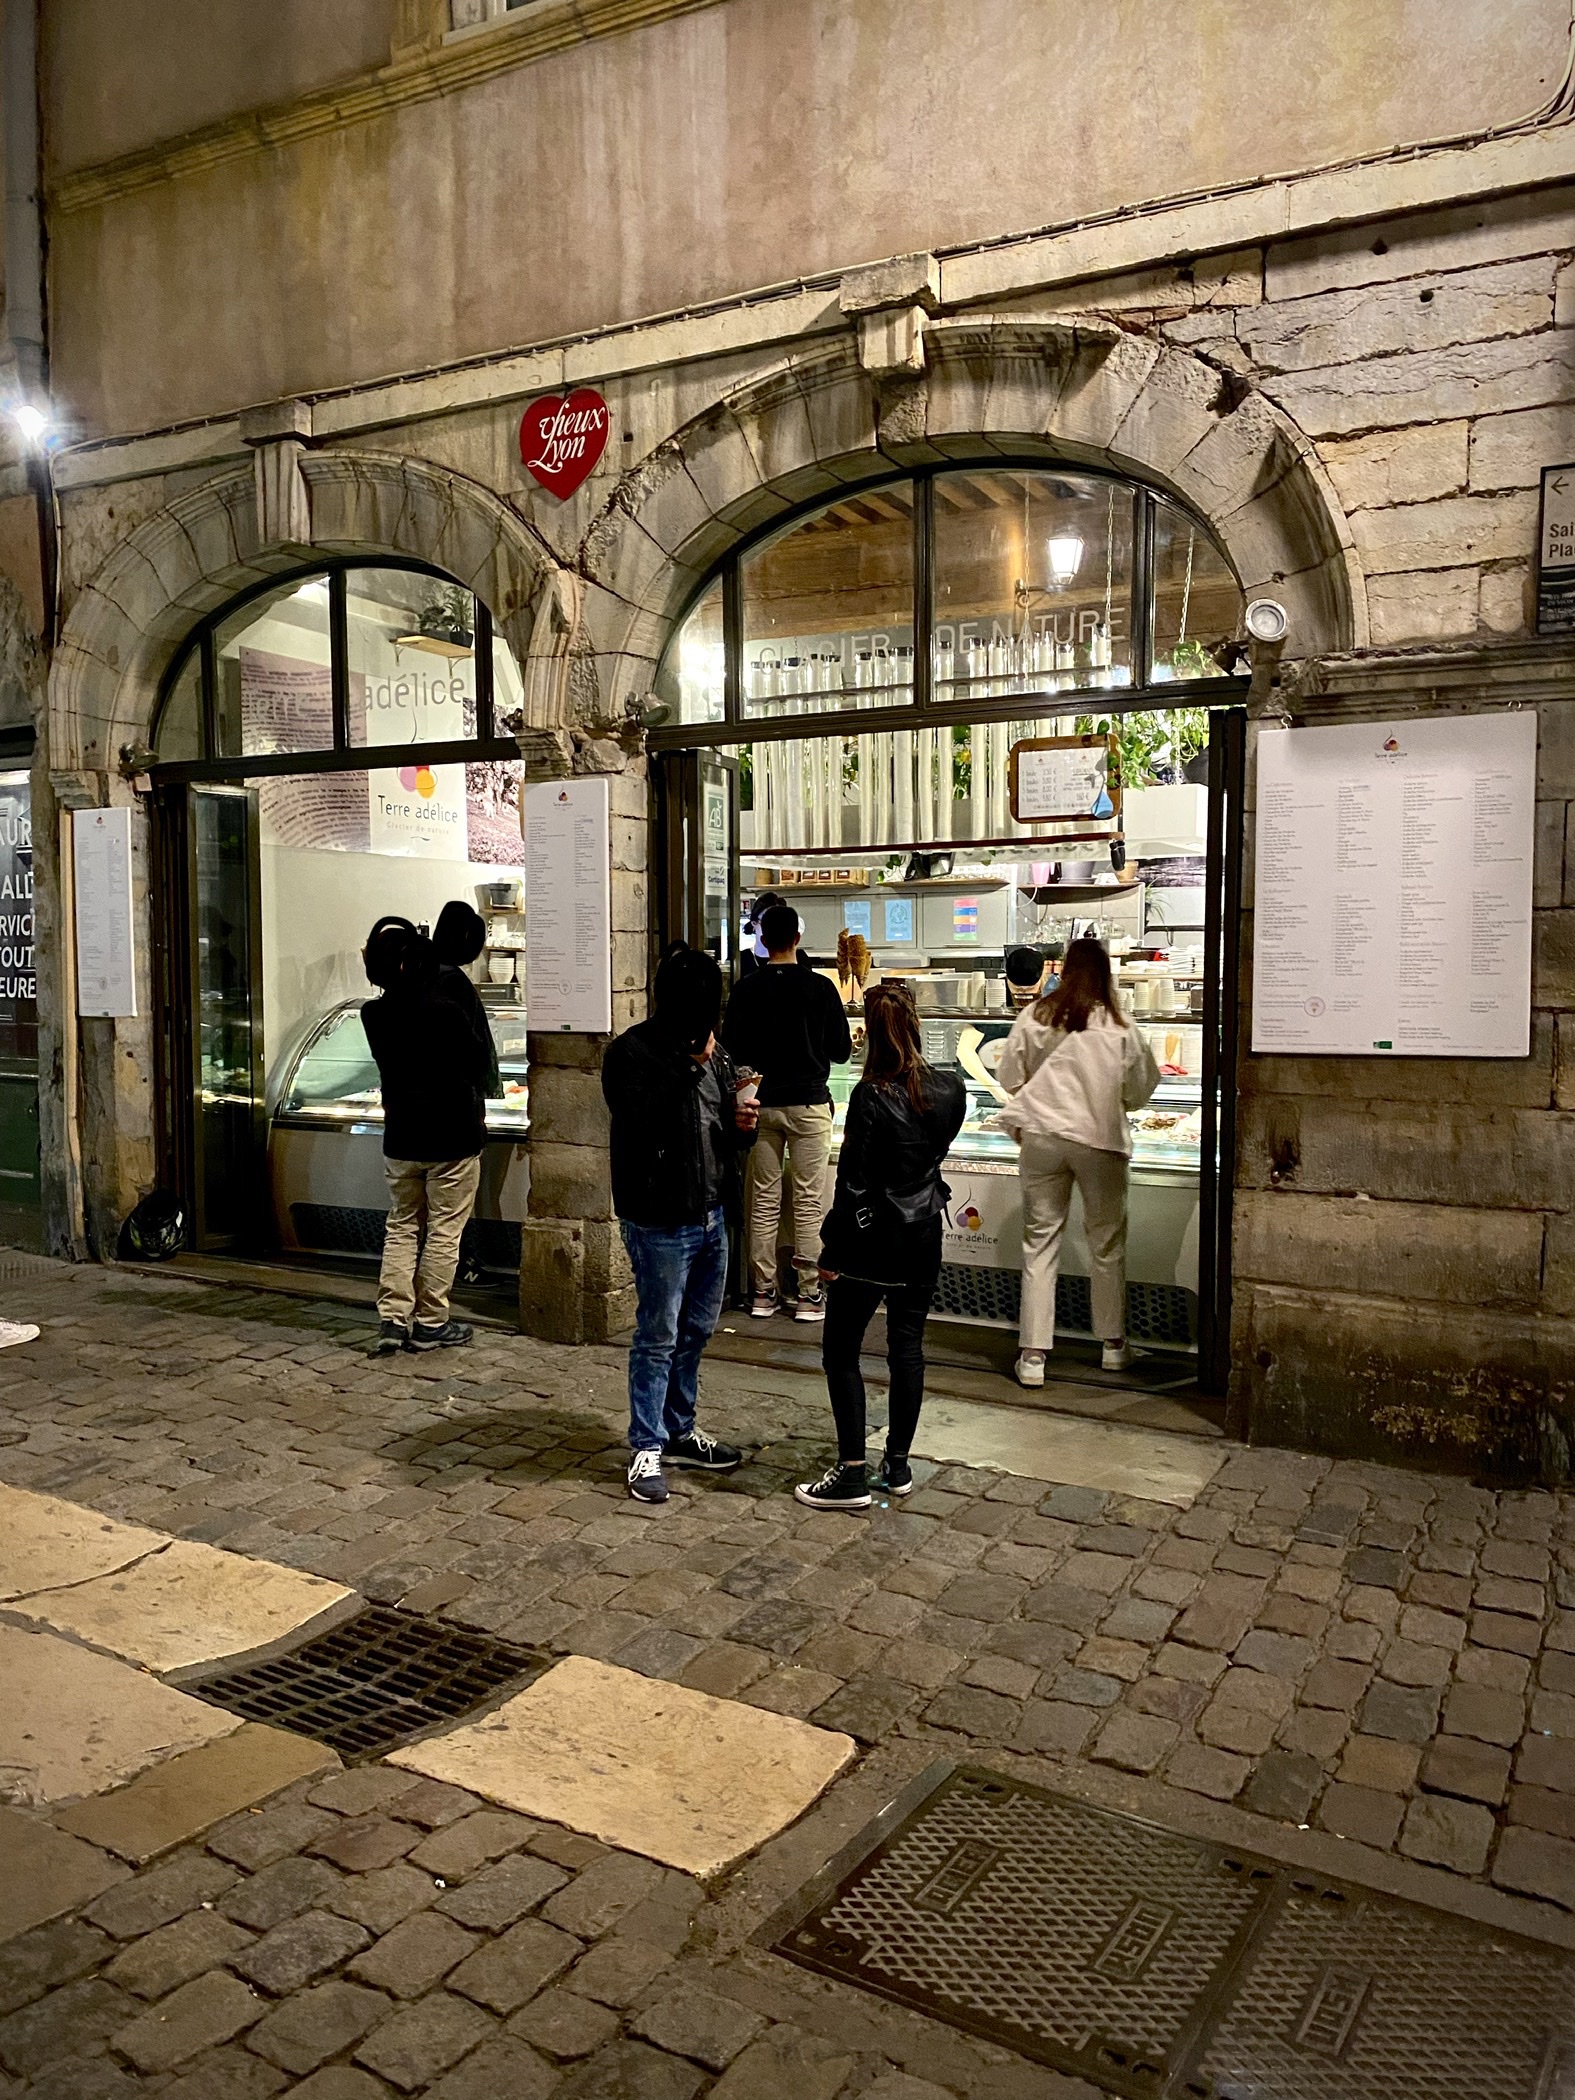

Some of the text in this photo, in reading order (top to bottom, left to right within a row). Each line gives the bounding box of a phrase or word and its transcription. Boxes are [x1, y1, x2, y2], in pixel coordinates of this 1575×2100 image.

[527, 435, 586, 474] Lyon
[1549, 543, 1575, 558] Pla
[935, 622, 979, 654] DE
[991, 607, 1127, 650] NATURE
[364, 672, 465, 711] adélice
[378, 795, 410, 817] Terre
[415, 802, 458, 824] adélice
[965, 1232, 999, 1245] adélice
